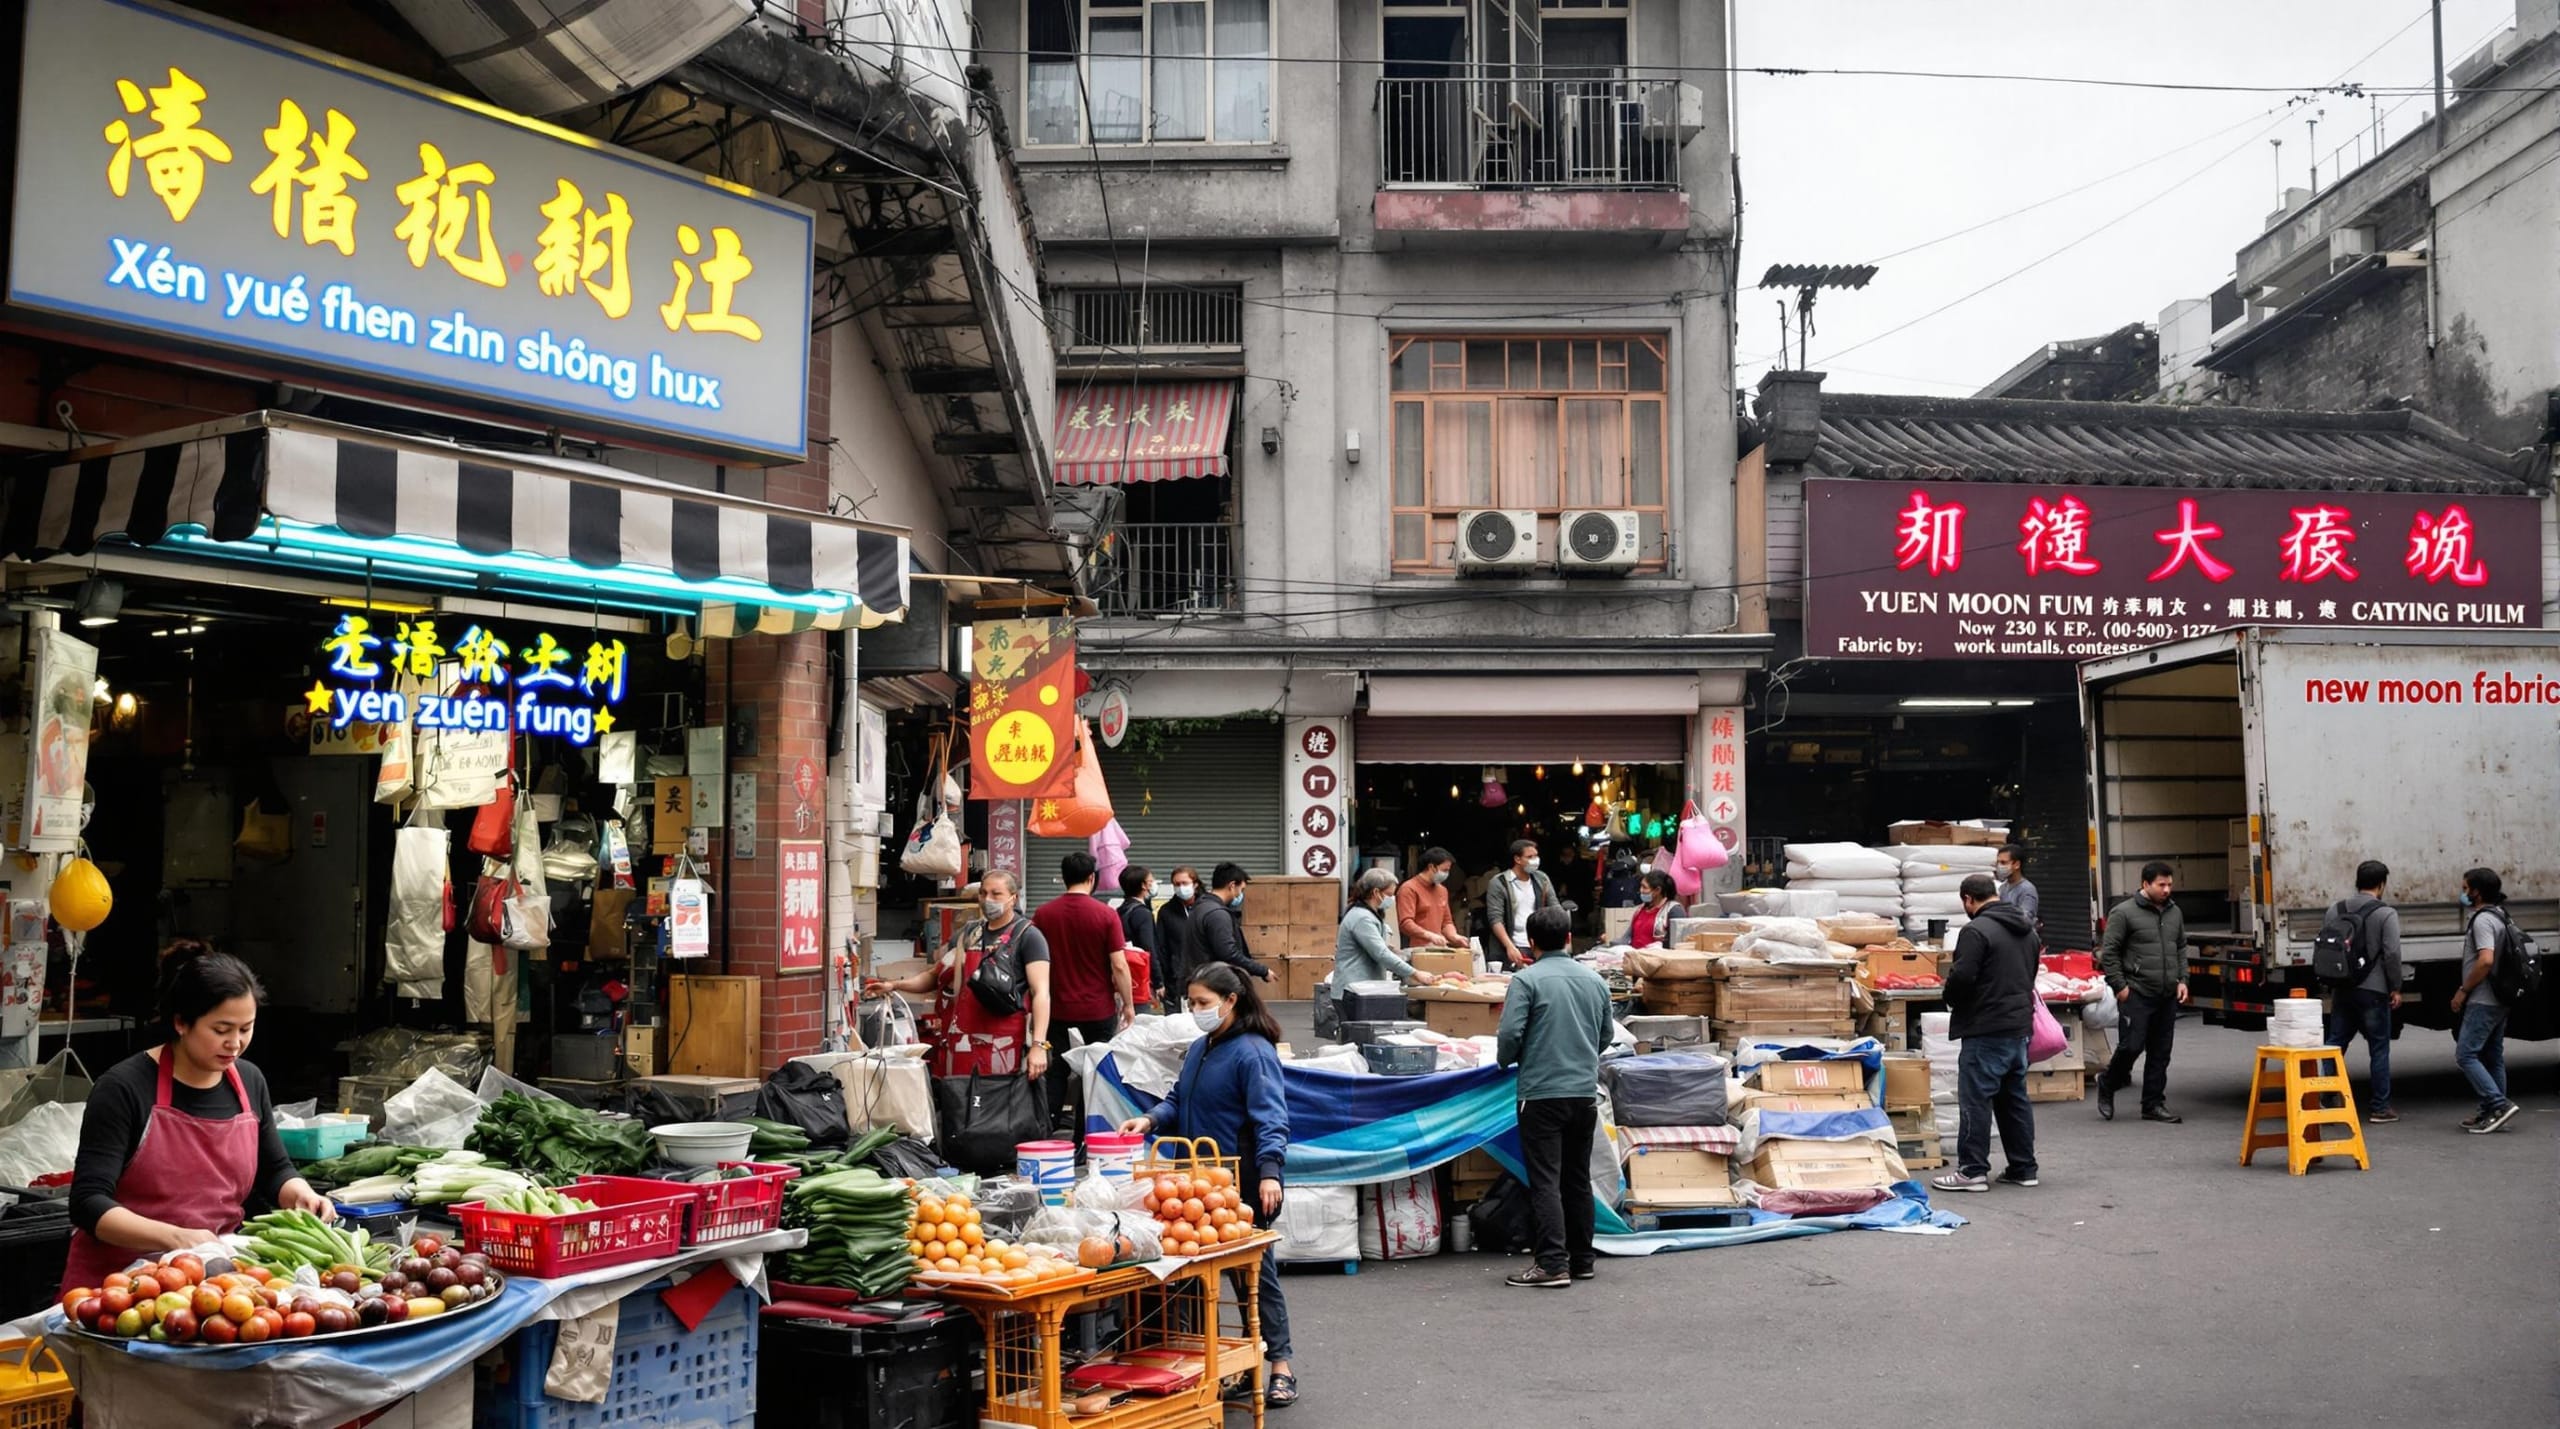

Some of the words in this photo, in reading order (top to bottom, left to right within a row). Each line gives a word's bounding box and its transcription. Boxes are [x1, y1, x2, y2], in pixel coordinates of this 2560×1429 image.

[429, 312, 505, 363] zhn
[651, 354, 721, 408] hux
[1860, 590, 1938, 614] YUEN
[1948, 592, 2031, 616] MOON
[2039, 594, 2093, 616] FUM
[2351, 601, 2450, 623] CATYING
[2457, 602, 2526, 624] PUILM
[1959, 619, 1996, 635] Now
[2005, 620, 2037, 636] 230
[2044, 620, 2058, 636] K
[1838, 636, 1893, 654] Fabric
[1896, 636, 1923, 655] by:
[1954, 638, 1996, 654] work
[2305, 678, 2370, 703] new
[2377, 678, 2463, 704] moon
[2472, 670, 2560, 705] fabric
[334, 687, 406, 728] yen
[515, 691, 593, 743] fung
